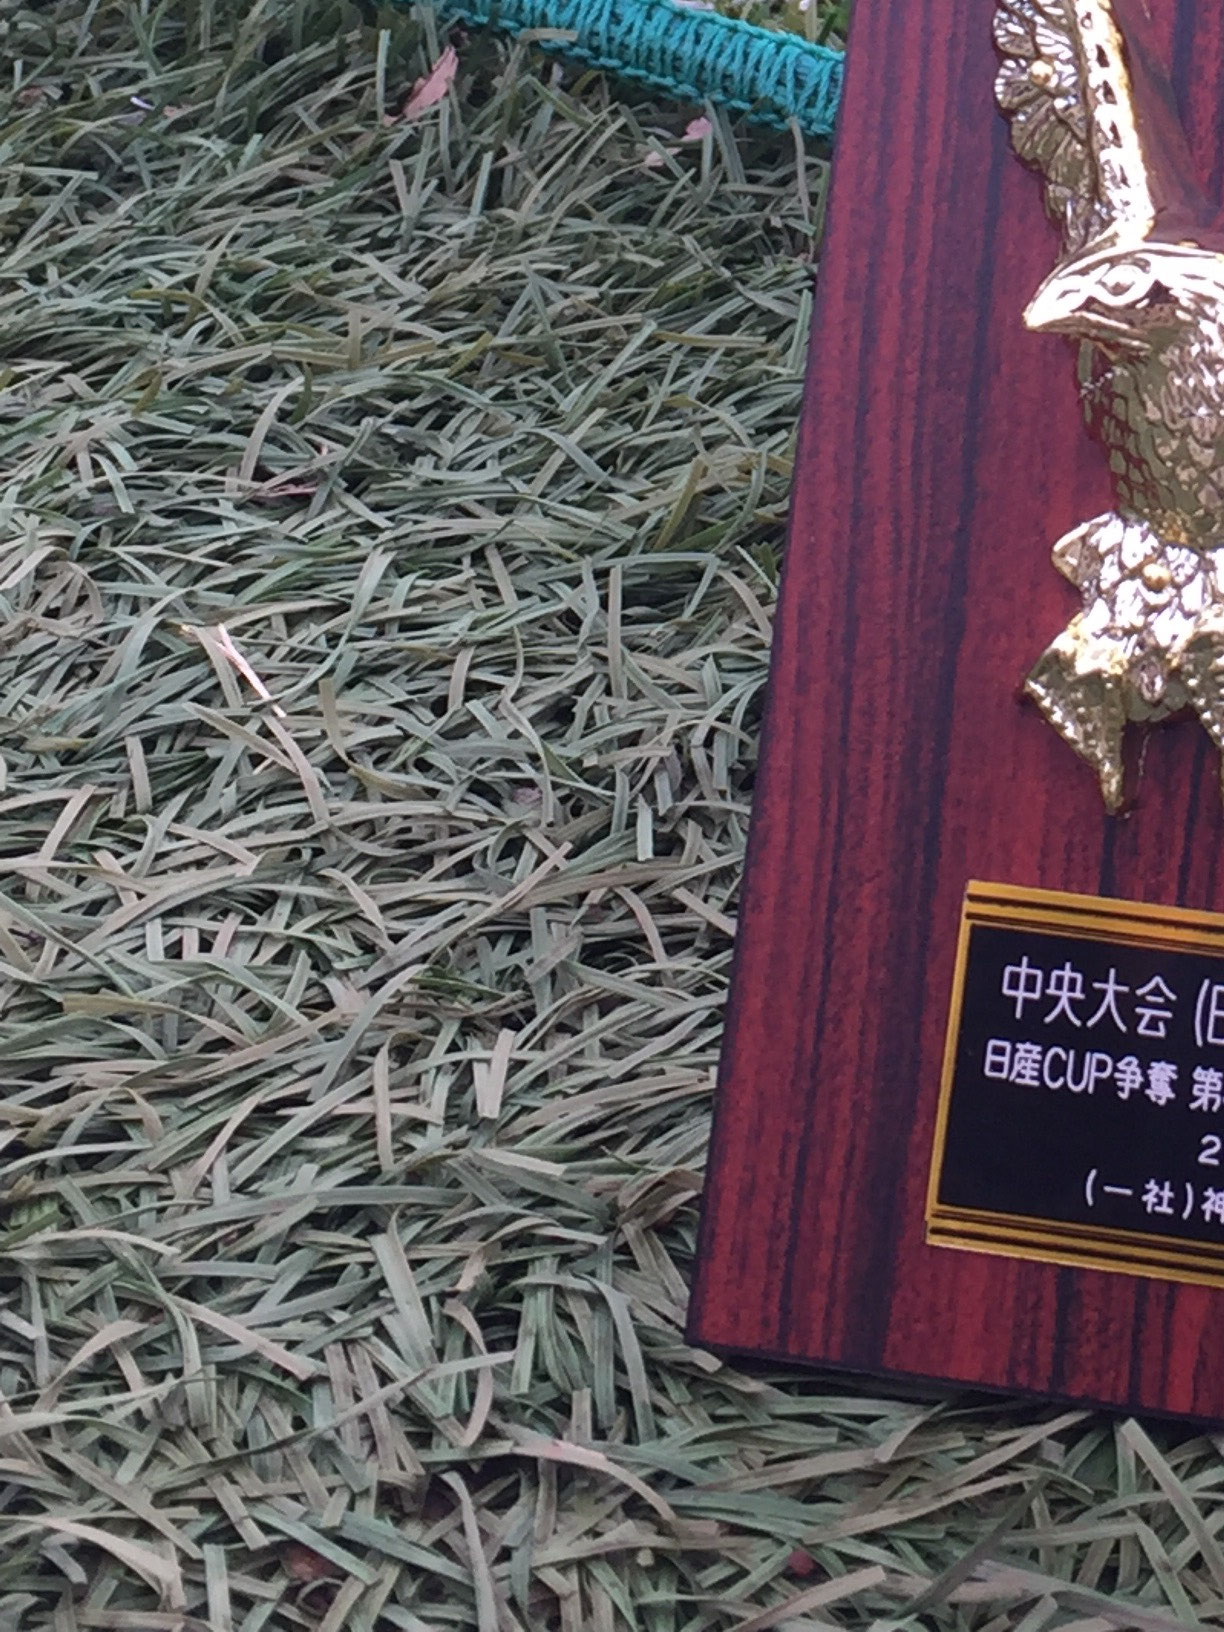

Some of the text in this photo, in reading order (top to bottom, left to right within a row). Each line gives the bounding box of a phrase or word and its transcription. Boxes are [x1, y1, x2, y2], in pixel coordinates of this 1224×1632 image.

[1001, 954, 1178, 1039] 中央大会
[983, 1039, 1178, 1107] 日産CUP争奪
